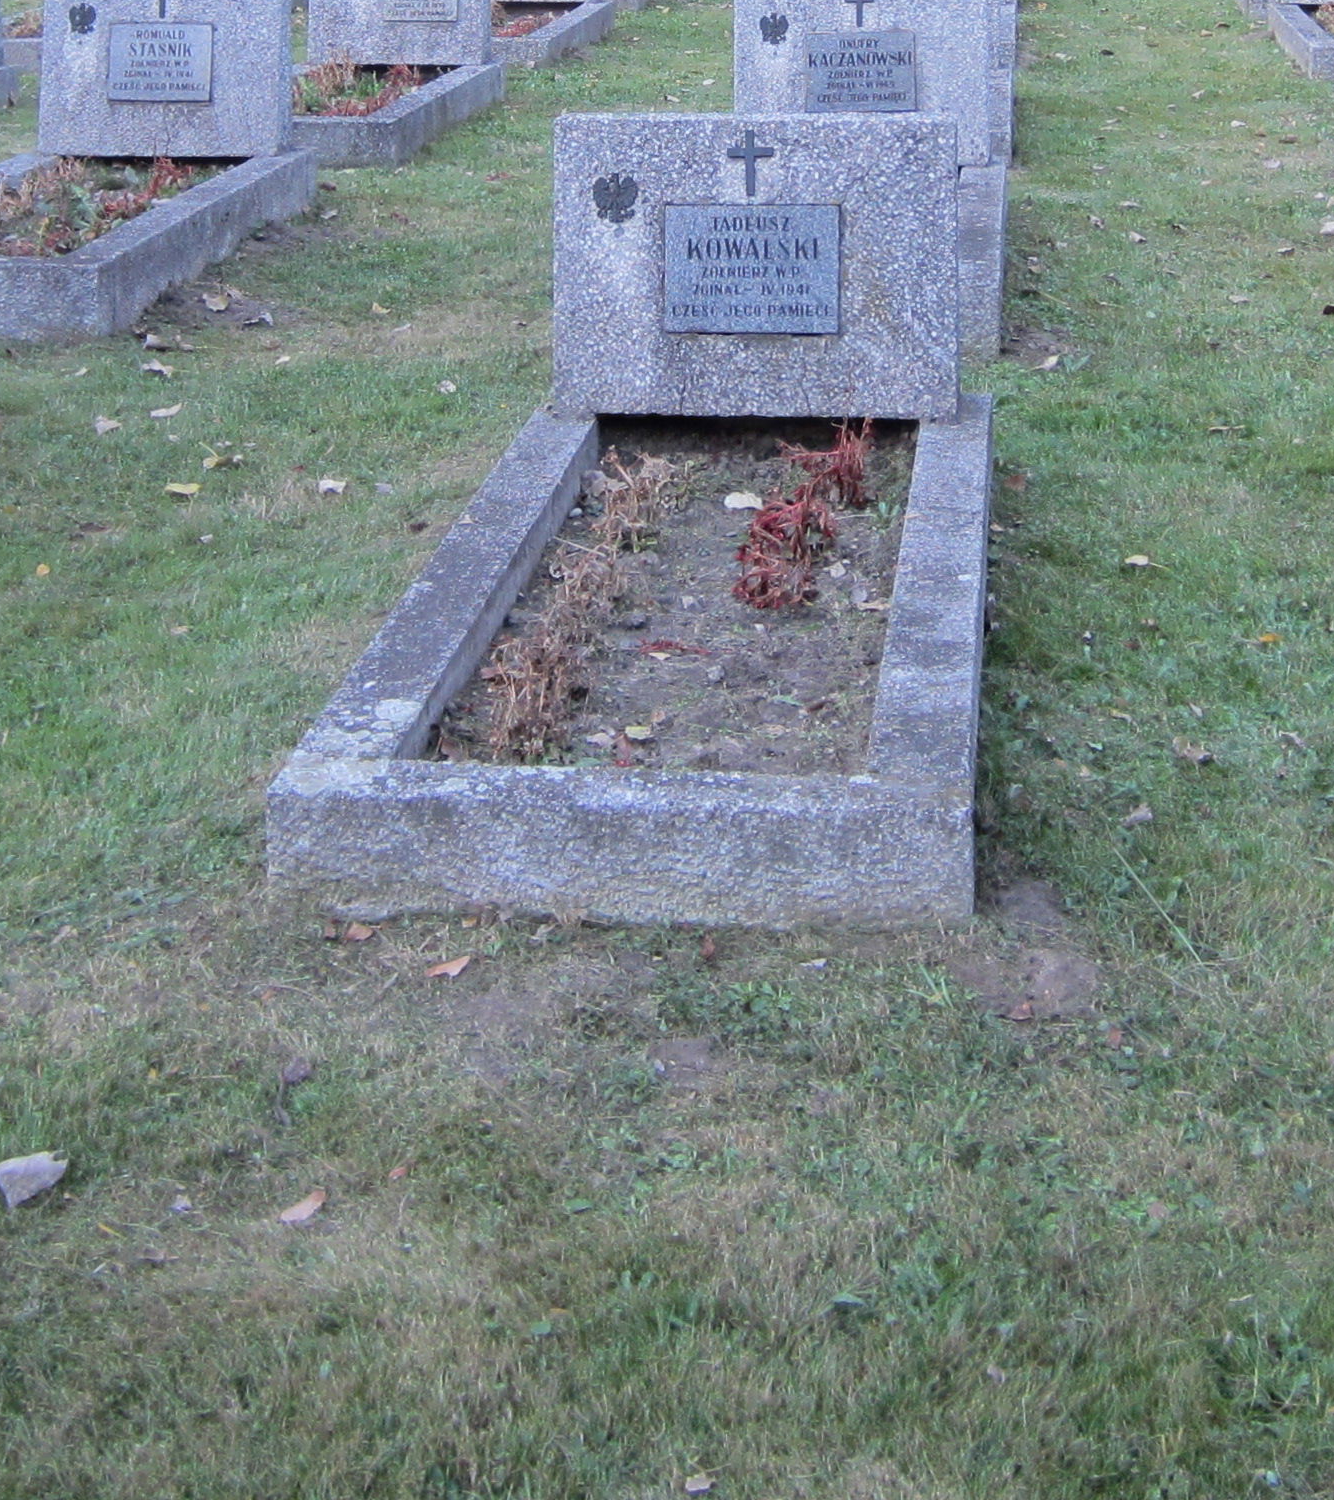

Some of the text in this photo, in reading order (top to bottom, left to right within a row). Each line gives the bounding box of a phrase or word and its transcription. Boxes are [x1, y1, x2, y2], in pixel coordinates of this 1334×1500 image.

[135, 29, 186, 41] ROMUALD
[807, 50, 913, 68] KACZANOWSKI
[711, 216, 791, 232] TADEUSZ
[687, 237, 820, 261] KOWALSKI
[724, 304, 762, 318] JEGO
